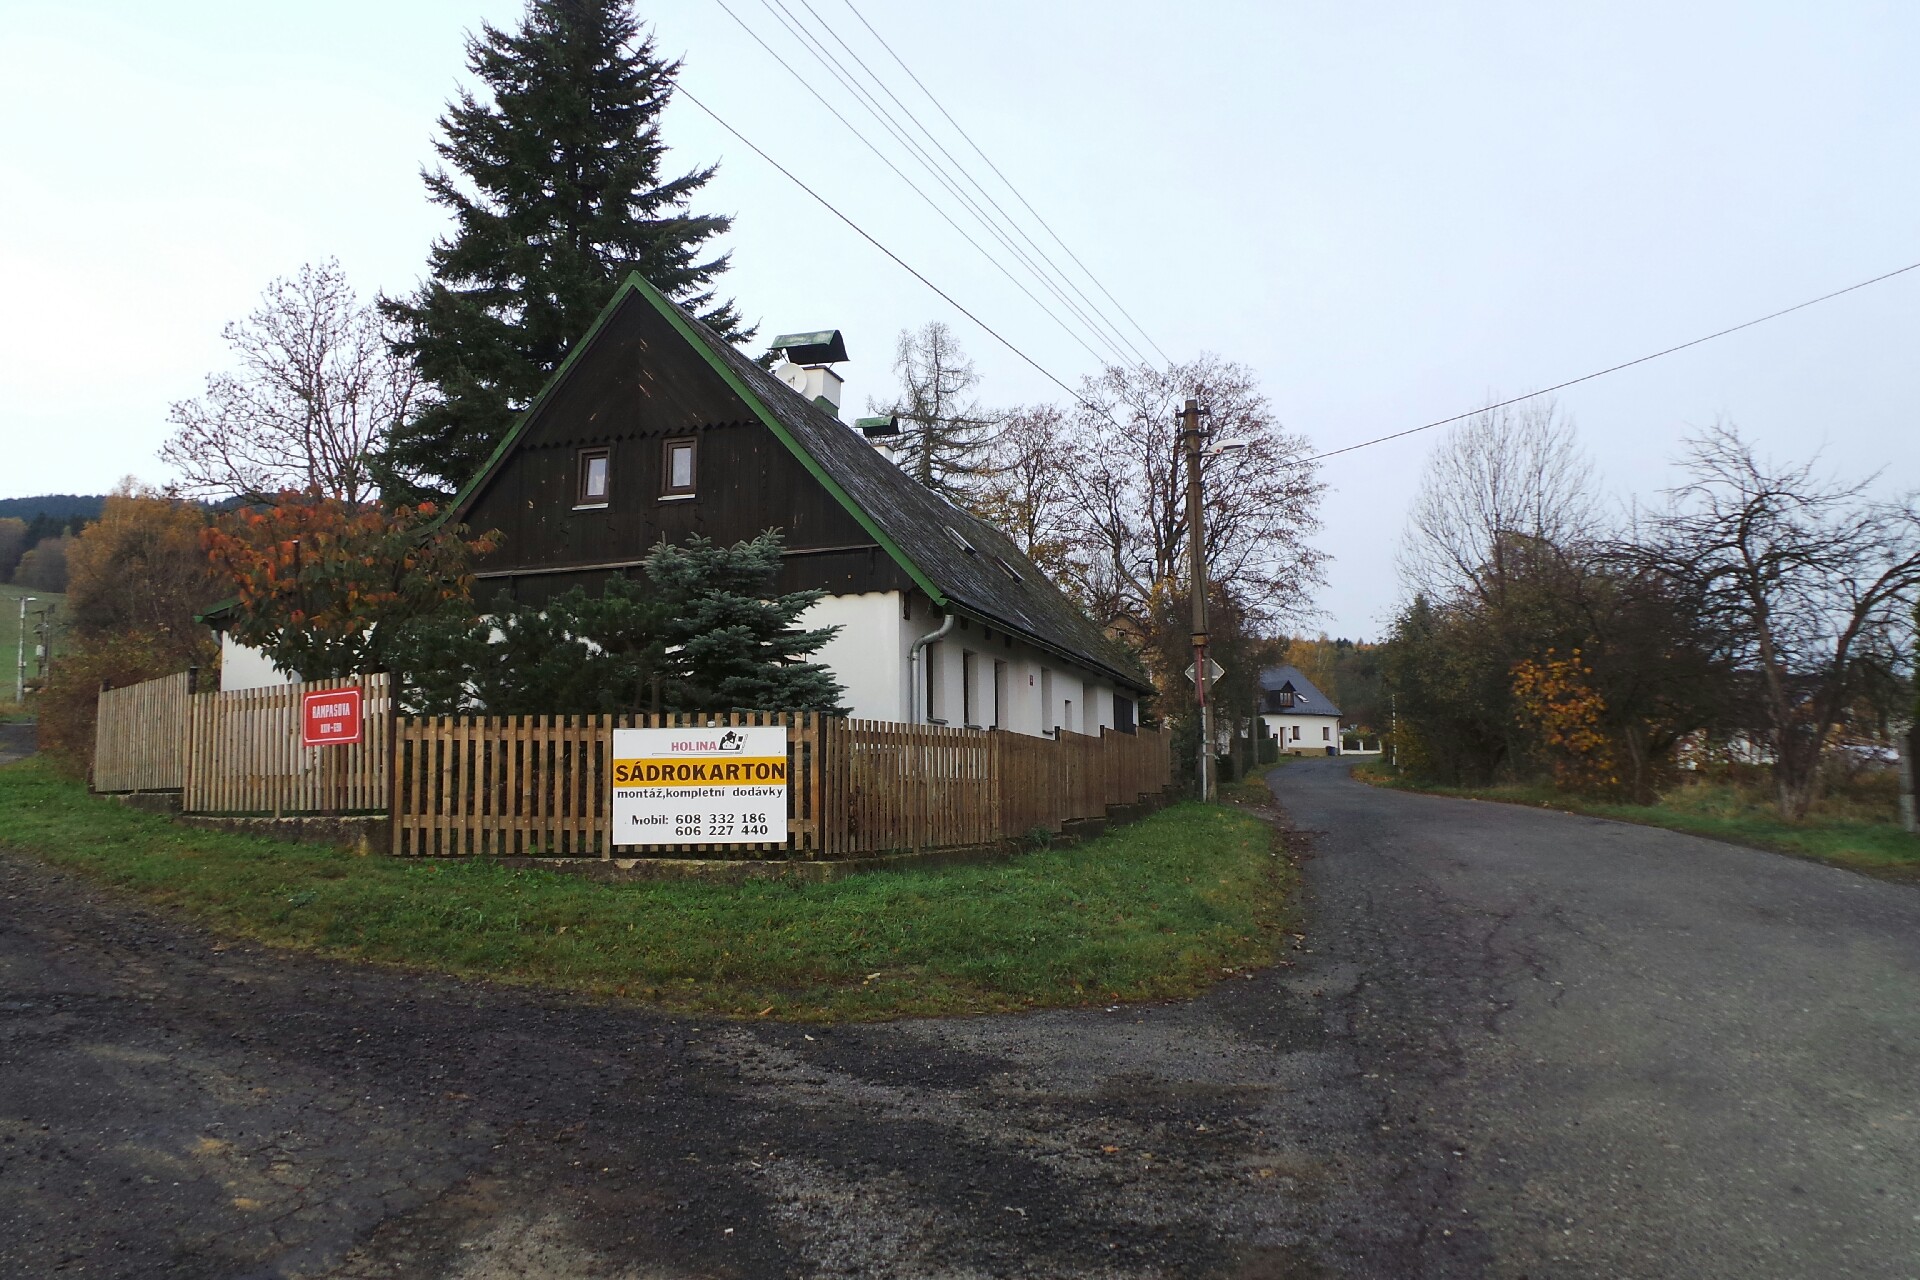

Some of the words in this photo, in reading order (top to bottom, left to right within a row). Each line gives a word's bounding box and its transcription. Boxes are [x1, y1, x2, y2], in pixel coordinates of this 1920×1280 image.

[671, 741, 717, 752] HOLINA
[615, 761, 785, 782] SÁDROKARTON
[732, 786, 783, 799] dodávky
[631, 814, 669, 826] Mobil:
[675, 814, 701, 824] 608
[709, 813, 735, 824] 332
[741, 812, 766, 823] 186
[675, 825, 701, 836] 606
[708, 825, 734, 836] 227
[741, 824, 768, 835] 440
